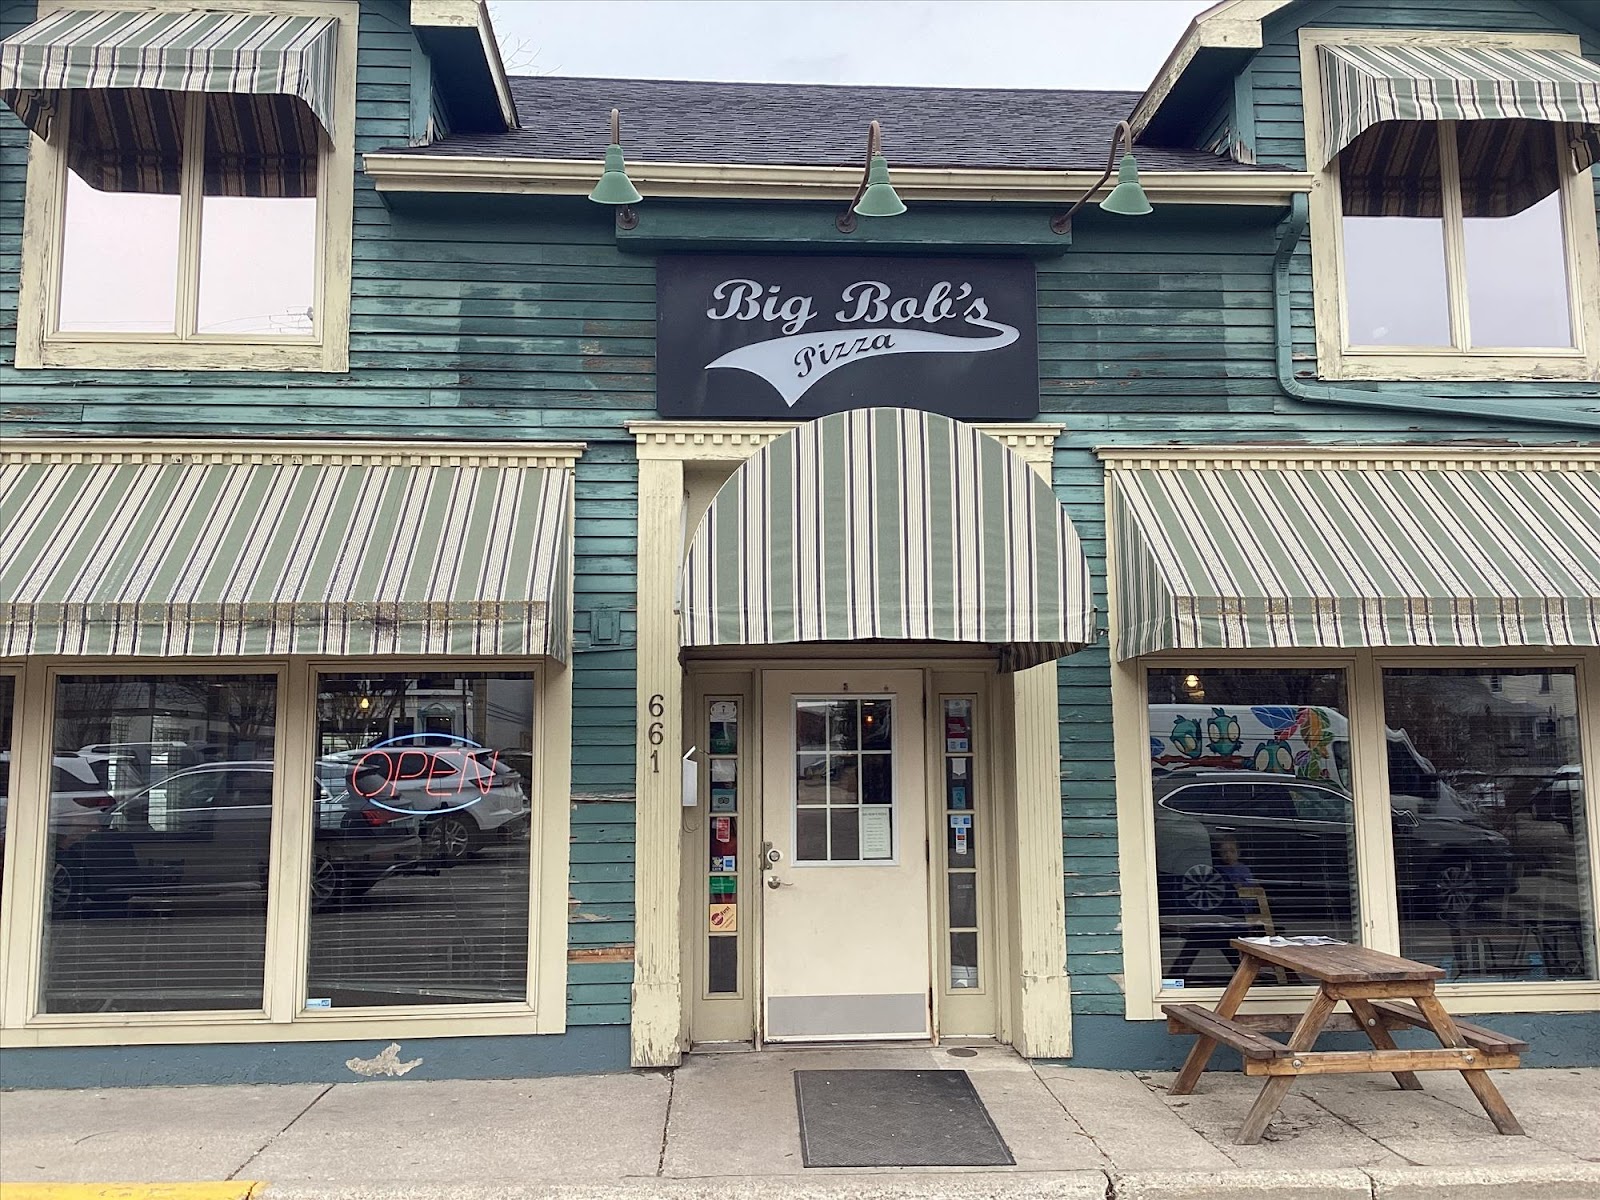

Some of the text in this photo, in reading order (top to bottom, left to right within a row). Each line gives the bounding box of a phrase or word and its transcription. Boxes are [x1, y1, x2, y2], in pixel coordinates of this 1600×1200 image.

[706, 278, 990, 335] Big Bob's
[794, 333, 896, 378] Pizza
[648, 694, 664, 773] 661
[352, 750, 499, 797] OPEN
